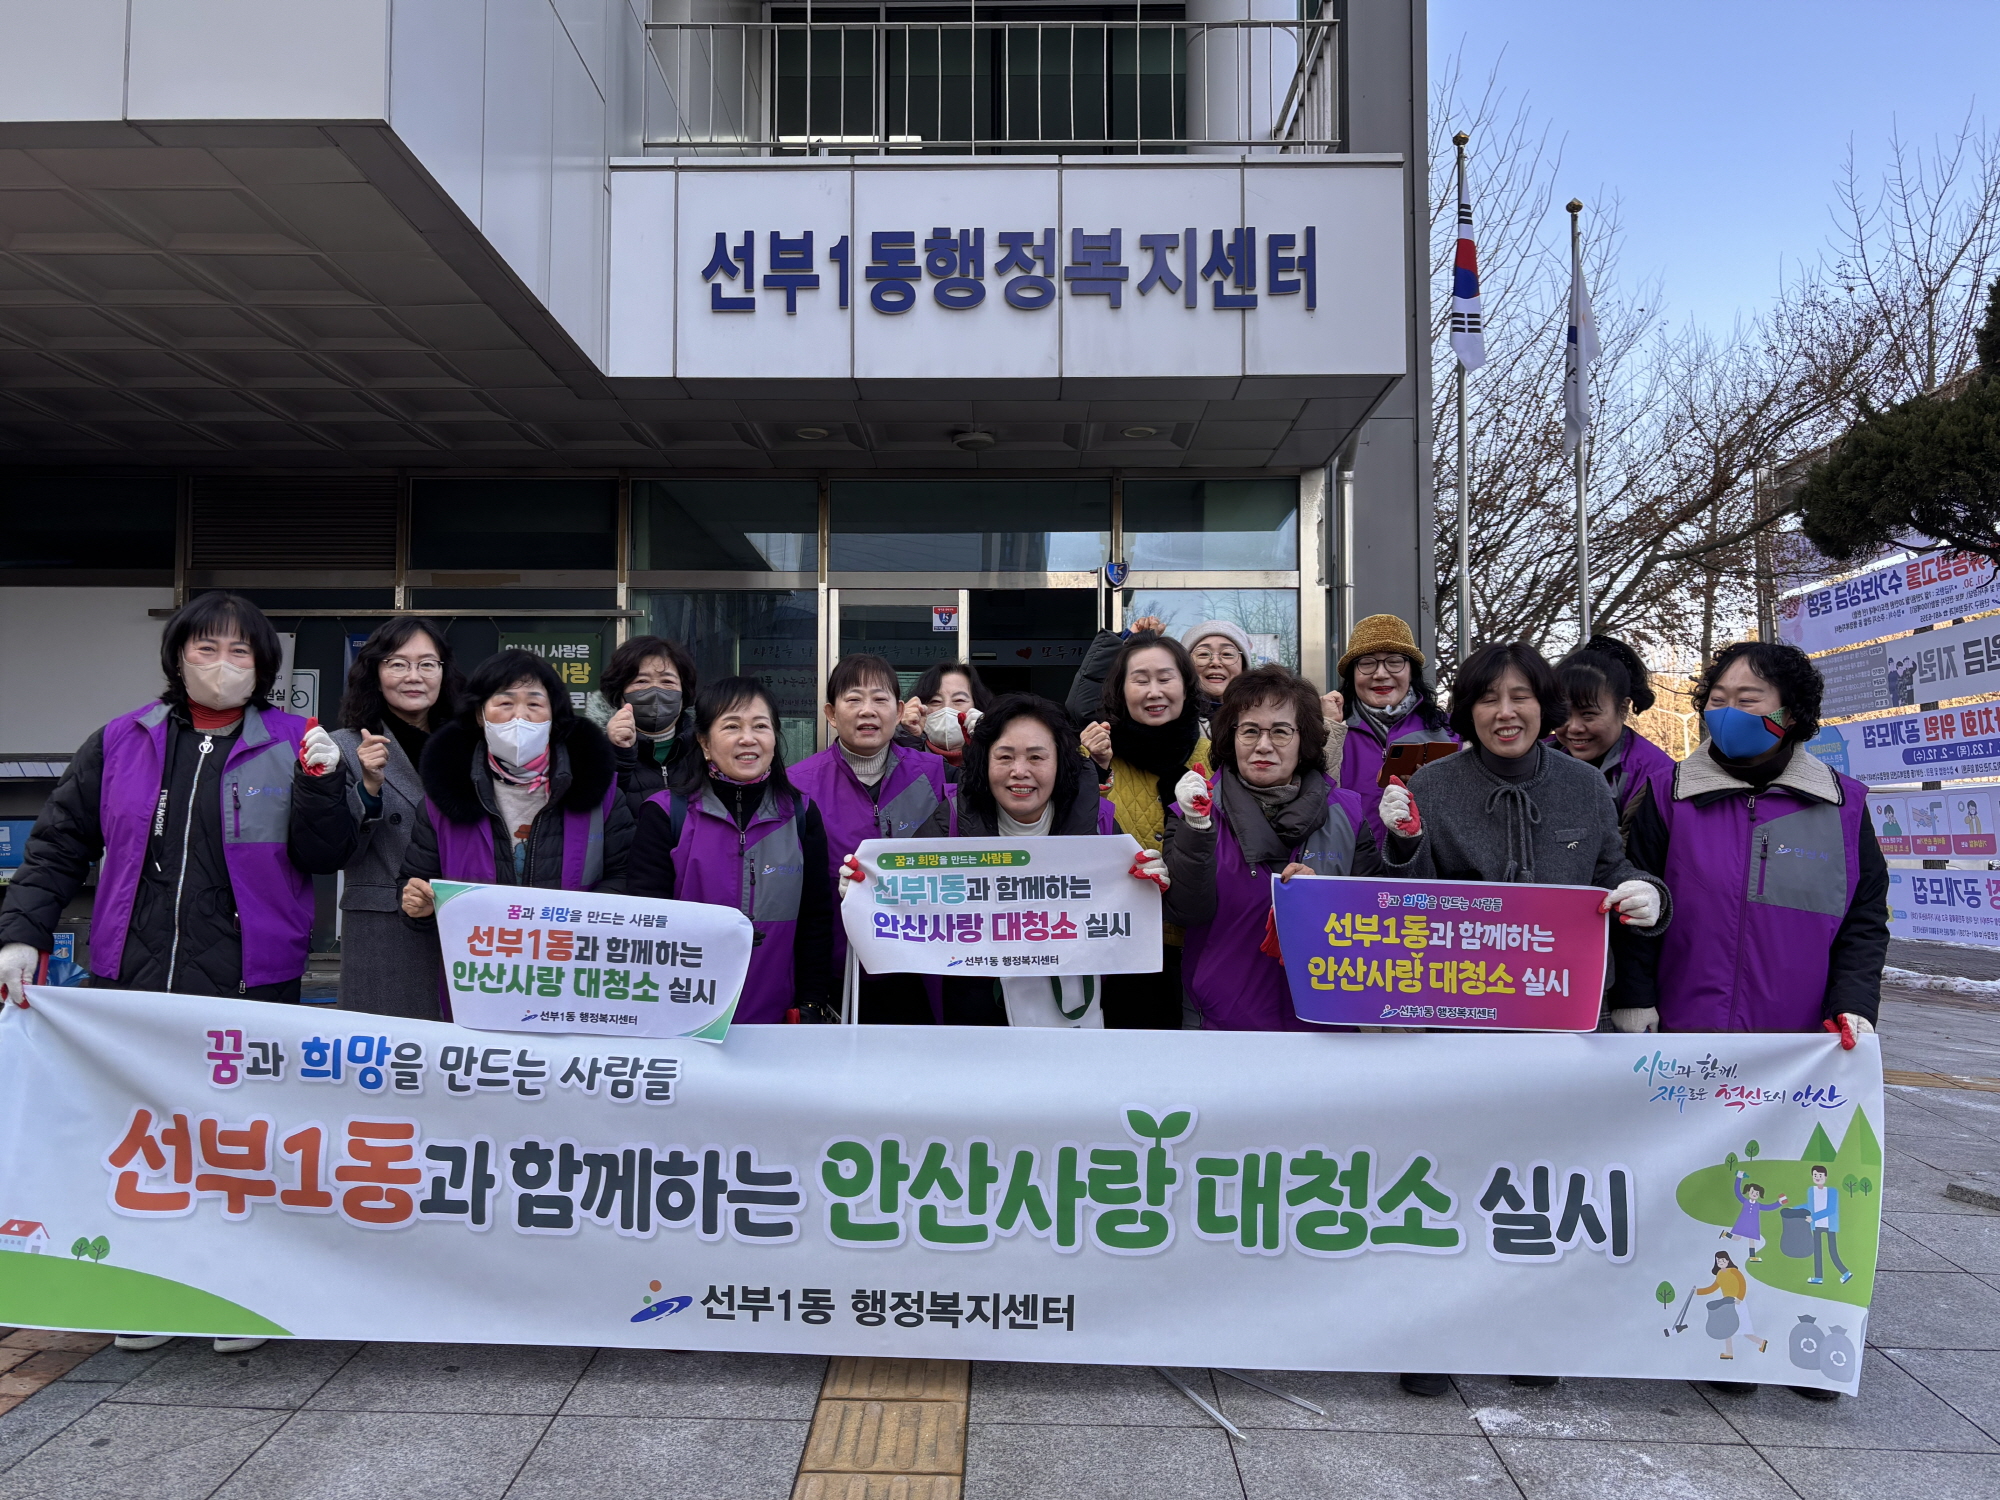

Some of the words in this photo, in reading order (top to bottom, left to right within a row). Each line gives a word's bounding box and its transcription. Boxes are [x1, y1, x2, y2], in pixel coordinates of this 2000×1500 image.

[701, 226, 1316, 314] 선부1동행정복지센터
[548, 644, 590, 659] 사랑은
[894, 855, 915, 867] 꿈과
[918, 853, 948, 866] 희망을
[951, 854, 977, 865] 만드는
[980, 852, 1012, 865] 사람들
[873, 874, 990, 905] 선부1동과
[996, 875, 1091, 901] 함께하는
[1378, 893, 1400, 908] 꿈과
[1402, 893, 1437, 909] 희망을
[1439, 895, 1469, 910] 만드는
[1472, 897, 1503, 912] 사람들
[507, 905, 535, 921] 꿈과
[540, 906, 582, 924] 희망을
[587, 910, 625, 926] 만드는
[629, 912, 668, 929] 사람들
[873, 911, 983, 943] 안산사랑
[992, 911, 1077, 941] 대청소
[1085, 912, 1131, 939] 실시
[1323, 913, 1454, 949] 선부1동과
[1459, 921, 1555, 953] 함께하는
[467, 926, 599, 962] 선부1동과
[606, 936, 703, 968] 함께하는
[965, 956, 998, 967] 선부1동
[1002, 955, 1059, 967] 행정복지센터
[453, 961, 565, 998] 안산사랑
[573, 967, 660, 1003] 대청소
[669, 976, 716, 1005] 실시
[1308, 955, 1424, 993] 안산사랑
[1429, 960, 1516, 995] 대청소
[1521, 967, 1569, 997] 실시
[540, 1010, 576, 1023] 선부1동
[579, 1012, 638, 1026] 행정복지센터
[1399, 1005, 1433, 1018] 선부1동
[1437, 1006, 1496, 1020] 행정복지센터
[207, 1030, 285, 1084] 꿈과
[300, 1035, 423, 1090] 희망을
[440, 1046, 546, 1097] 만드는
[559, 1055, 677, 1101] 사람들
[1633, 1050, 1696, 1087] 시민과
[1649, 1085, 1709, 1113] 자유로운
[1714, 1084, 1787, 1113] 혁신도시
[1792, 1084, 1849, 1109] 안산
[109, 1108, 495, 1225] 선부1동과
[510, 1140, 801, 1237] 함께하는
[821, 1136, 1177, 1248] 안산사랑
[1196, 1148, 1461, 1252] 대청소
[1479, 1165, 1627, 1257] 실시
[700, 1284, 836, 1325] 선부1동
[851, 1288, 1075, 1331] 행정복지센터
